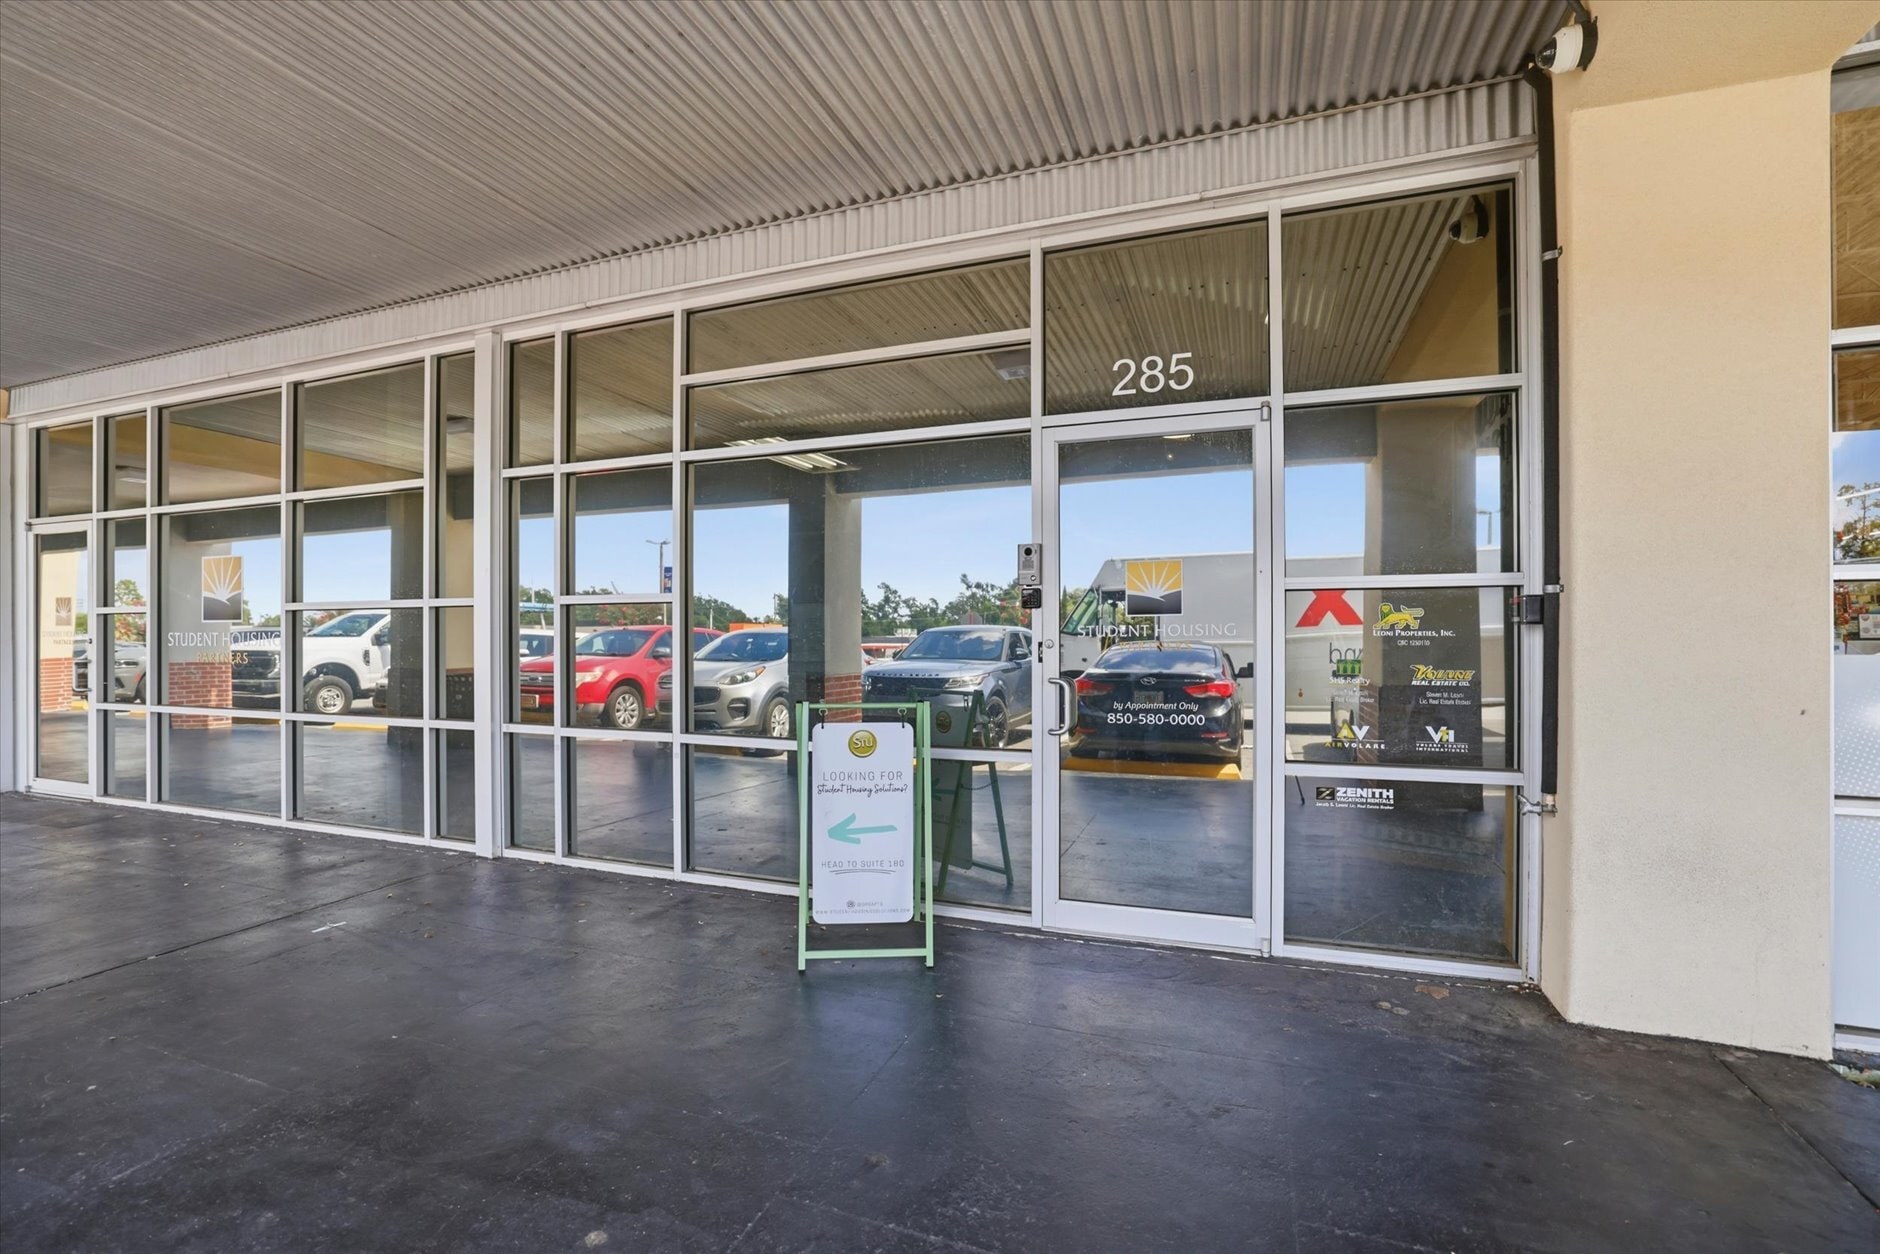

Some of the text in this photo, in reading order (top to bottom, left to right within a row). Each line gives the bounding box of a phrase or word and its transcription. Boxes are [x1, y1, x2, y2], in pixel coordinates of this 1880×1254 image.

[1112, 352, 1194, 396] 285
[1077, 622, 1237, 638] STUDENT HOUSING
[167, 631, 281, 648] STUDENT HOUSING
[1113, 701, 1199, 712] by Appointment Only
[1107, 712, 1206, 725] 850-580-0000
[822, 770, 903, 782] LOOKING FOR
[816, 782, 909, 798] Student Housing Solutions?
[1337, 787, 1394, 799] ZENITH
[1336, 796, 1366, 804] VACATION
[821, 859, 905, 869] HEAD TO SUITE 180
